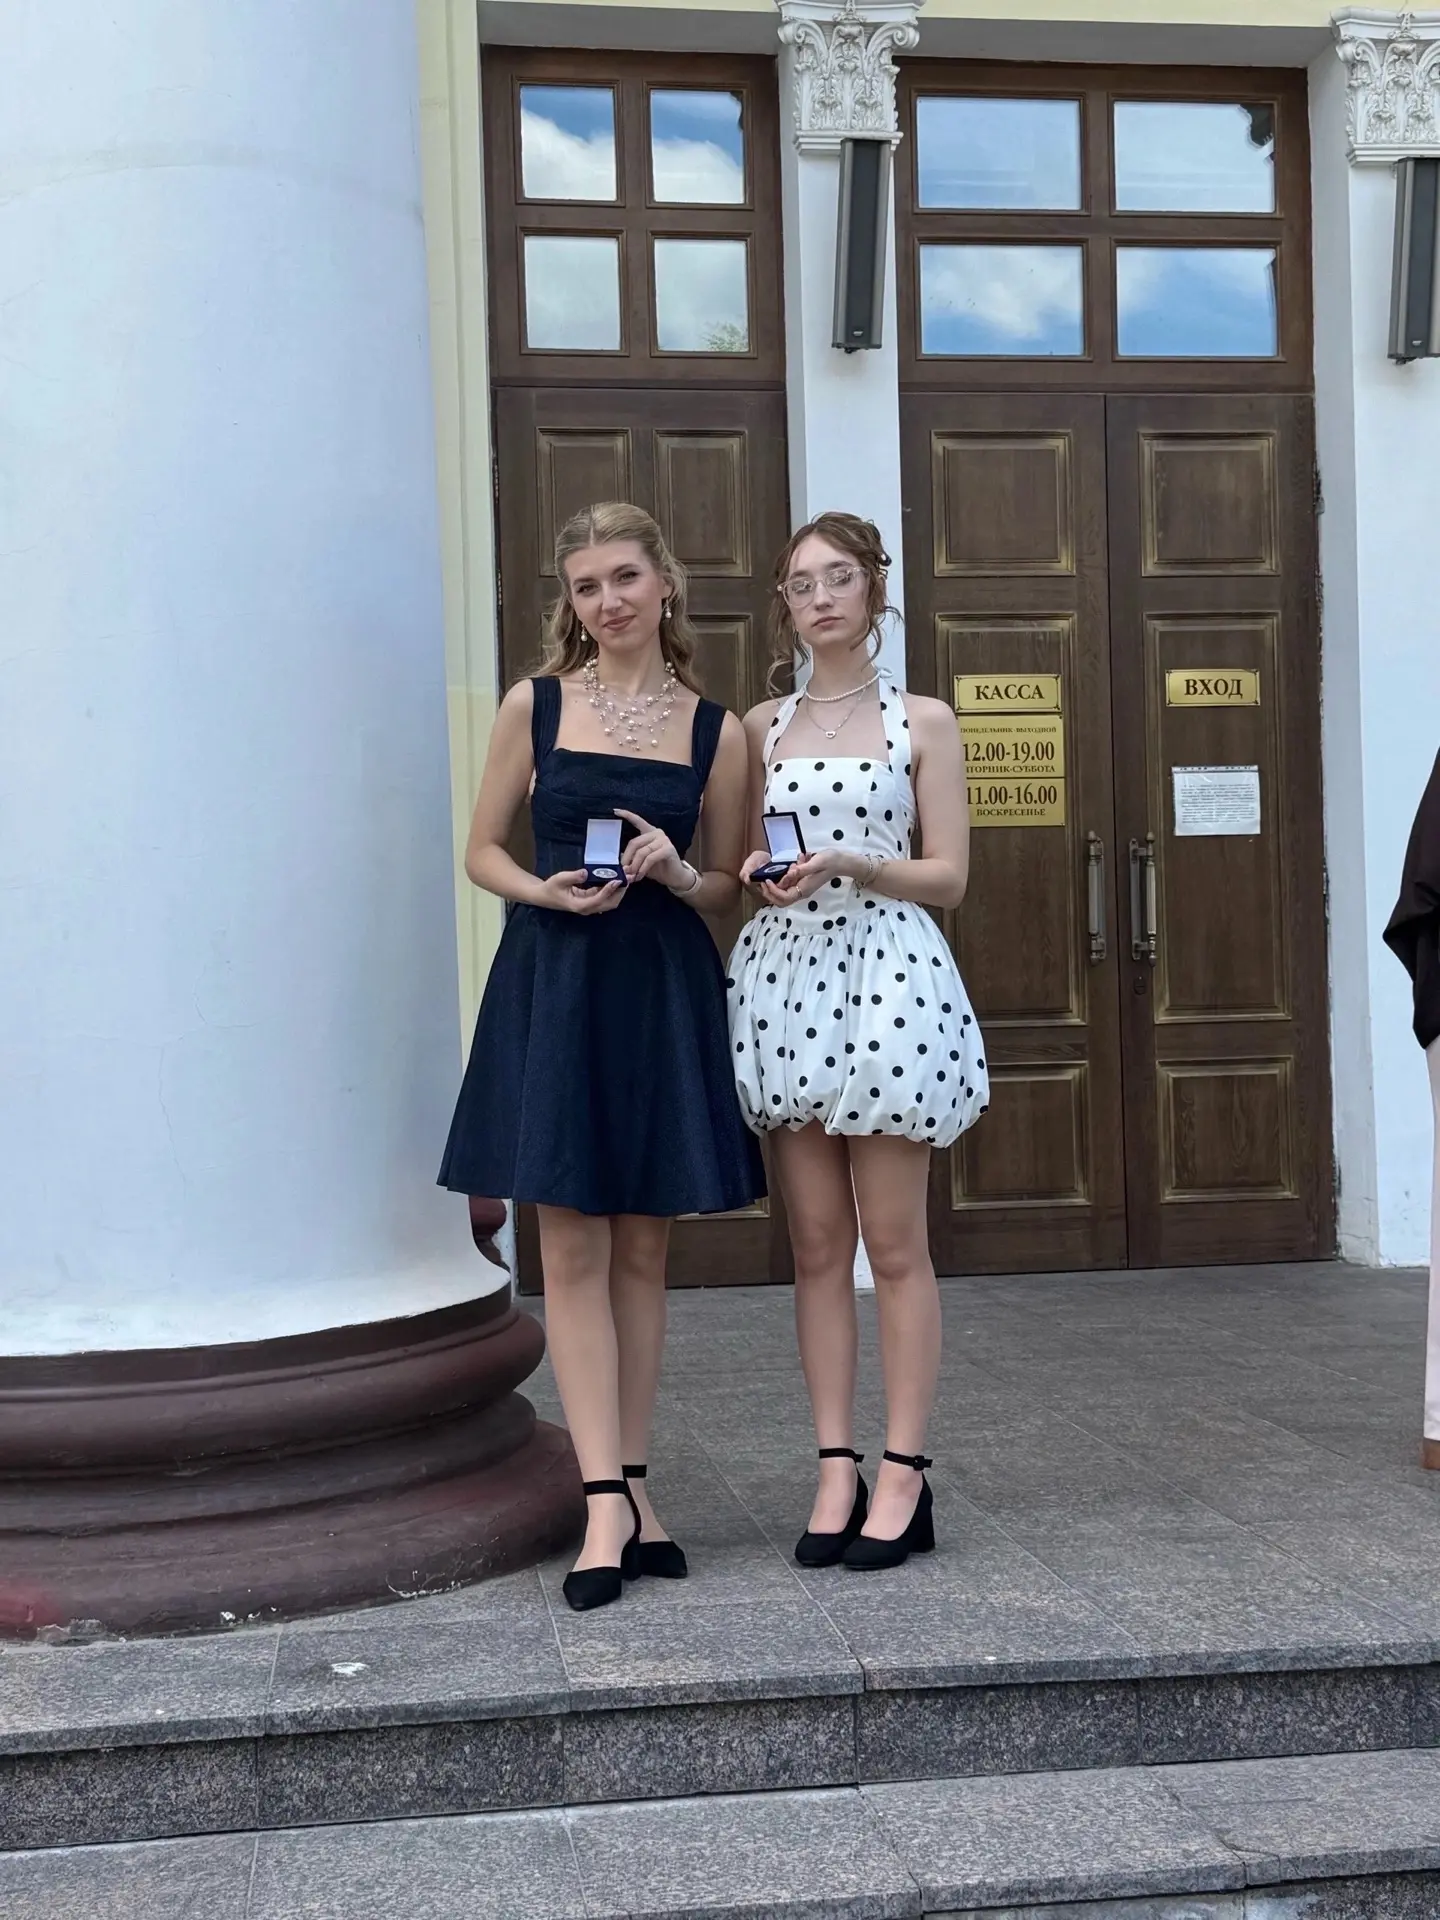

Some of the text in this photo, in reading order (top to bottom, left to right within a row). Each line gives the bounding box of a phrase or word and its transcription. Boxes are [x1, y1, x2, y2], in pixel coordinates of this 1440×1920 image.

[974, 684, 1045, 700] КАССА
[1184, 678, 1243, 699] ВХОД
[963, 741, 1055, 763] 12.00-19.00
[966, 782, 1057, 805] 11.00-16.00
[976, 808, 1046, 816] ВОСКРЕСЕНЬЕ
